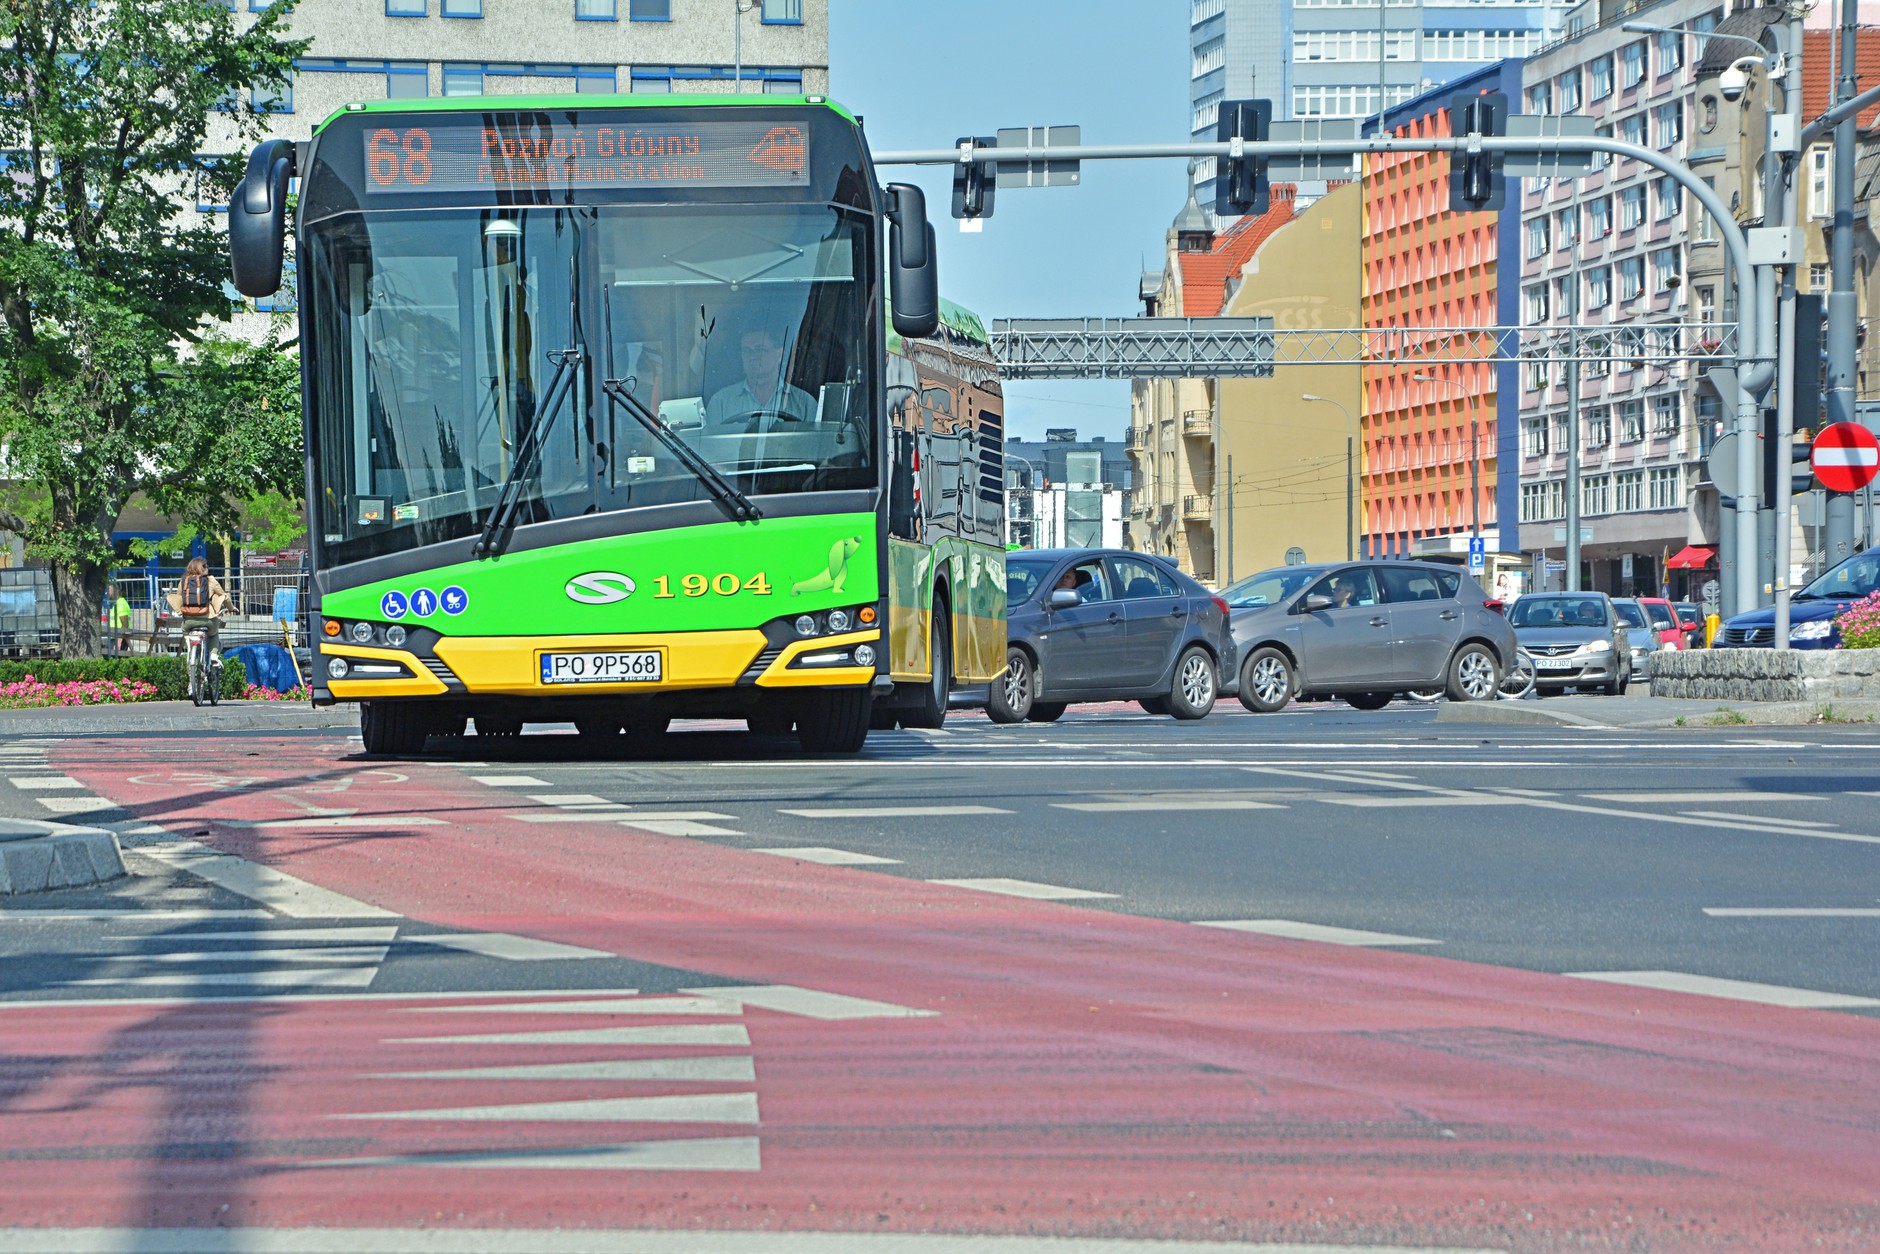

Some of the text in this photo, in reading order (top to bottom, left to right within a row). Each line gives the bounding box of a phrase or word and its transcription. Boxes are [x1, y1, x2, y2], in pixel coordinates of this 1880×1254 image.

[481, 127, 701, 158] Poznań Główny
[369, 128, 433, 185] 68
[563, 162, 616, 181] Main
[619, 161, 705, 181] Station
[1472, 554, 1482, 567] P
[653, 571, 773, 599] 1904
[555, 654, 656, 676] PO 9P568
